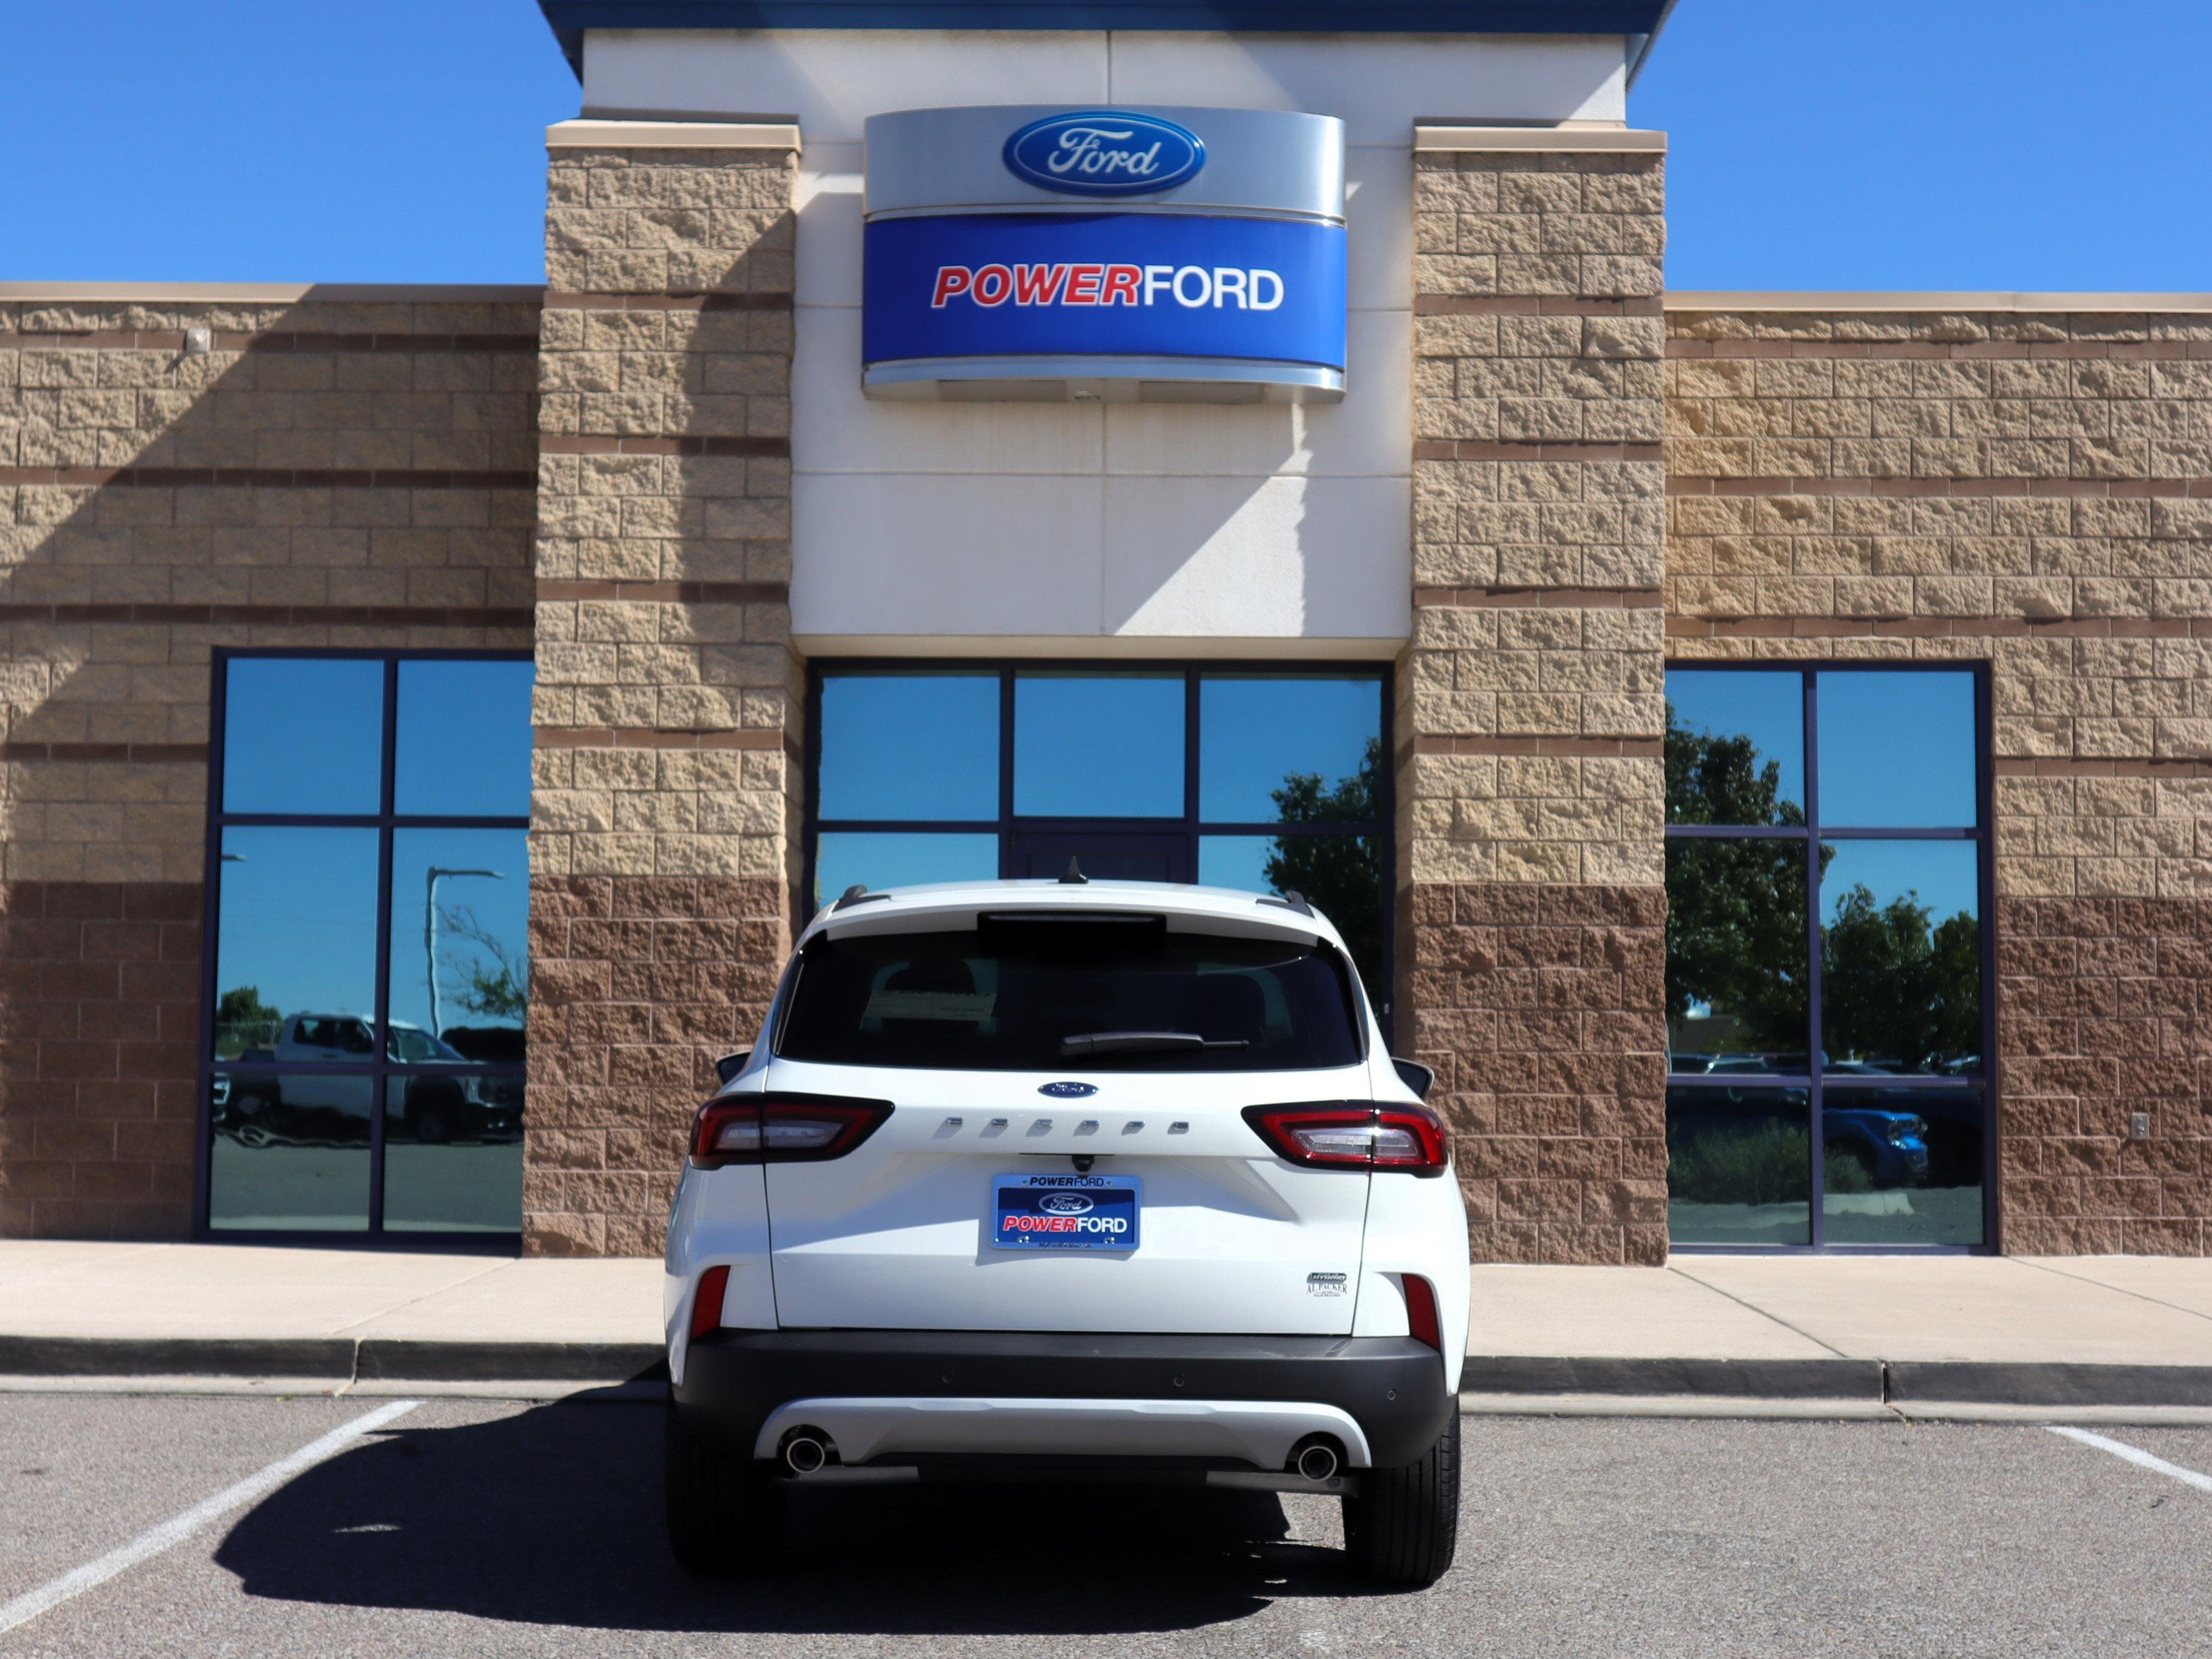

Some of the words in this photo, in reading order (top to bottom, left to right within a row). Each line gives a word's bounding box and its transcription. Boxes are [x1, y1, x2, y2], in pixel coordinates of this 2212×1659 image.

[1048, 127, 1162, 174] Ford
[930, 263, 1285, 310] POWERFORD
[1029, 1176, 1104, 1187] POWERFORD
[1050, 1196, 1082, 1210] Ford
[1002, 1215, 1128, 1233] POWERFORD
[1306, 1284, 1316, 1295] AL
[1318, 1283, 1347, 1295] PACKER
